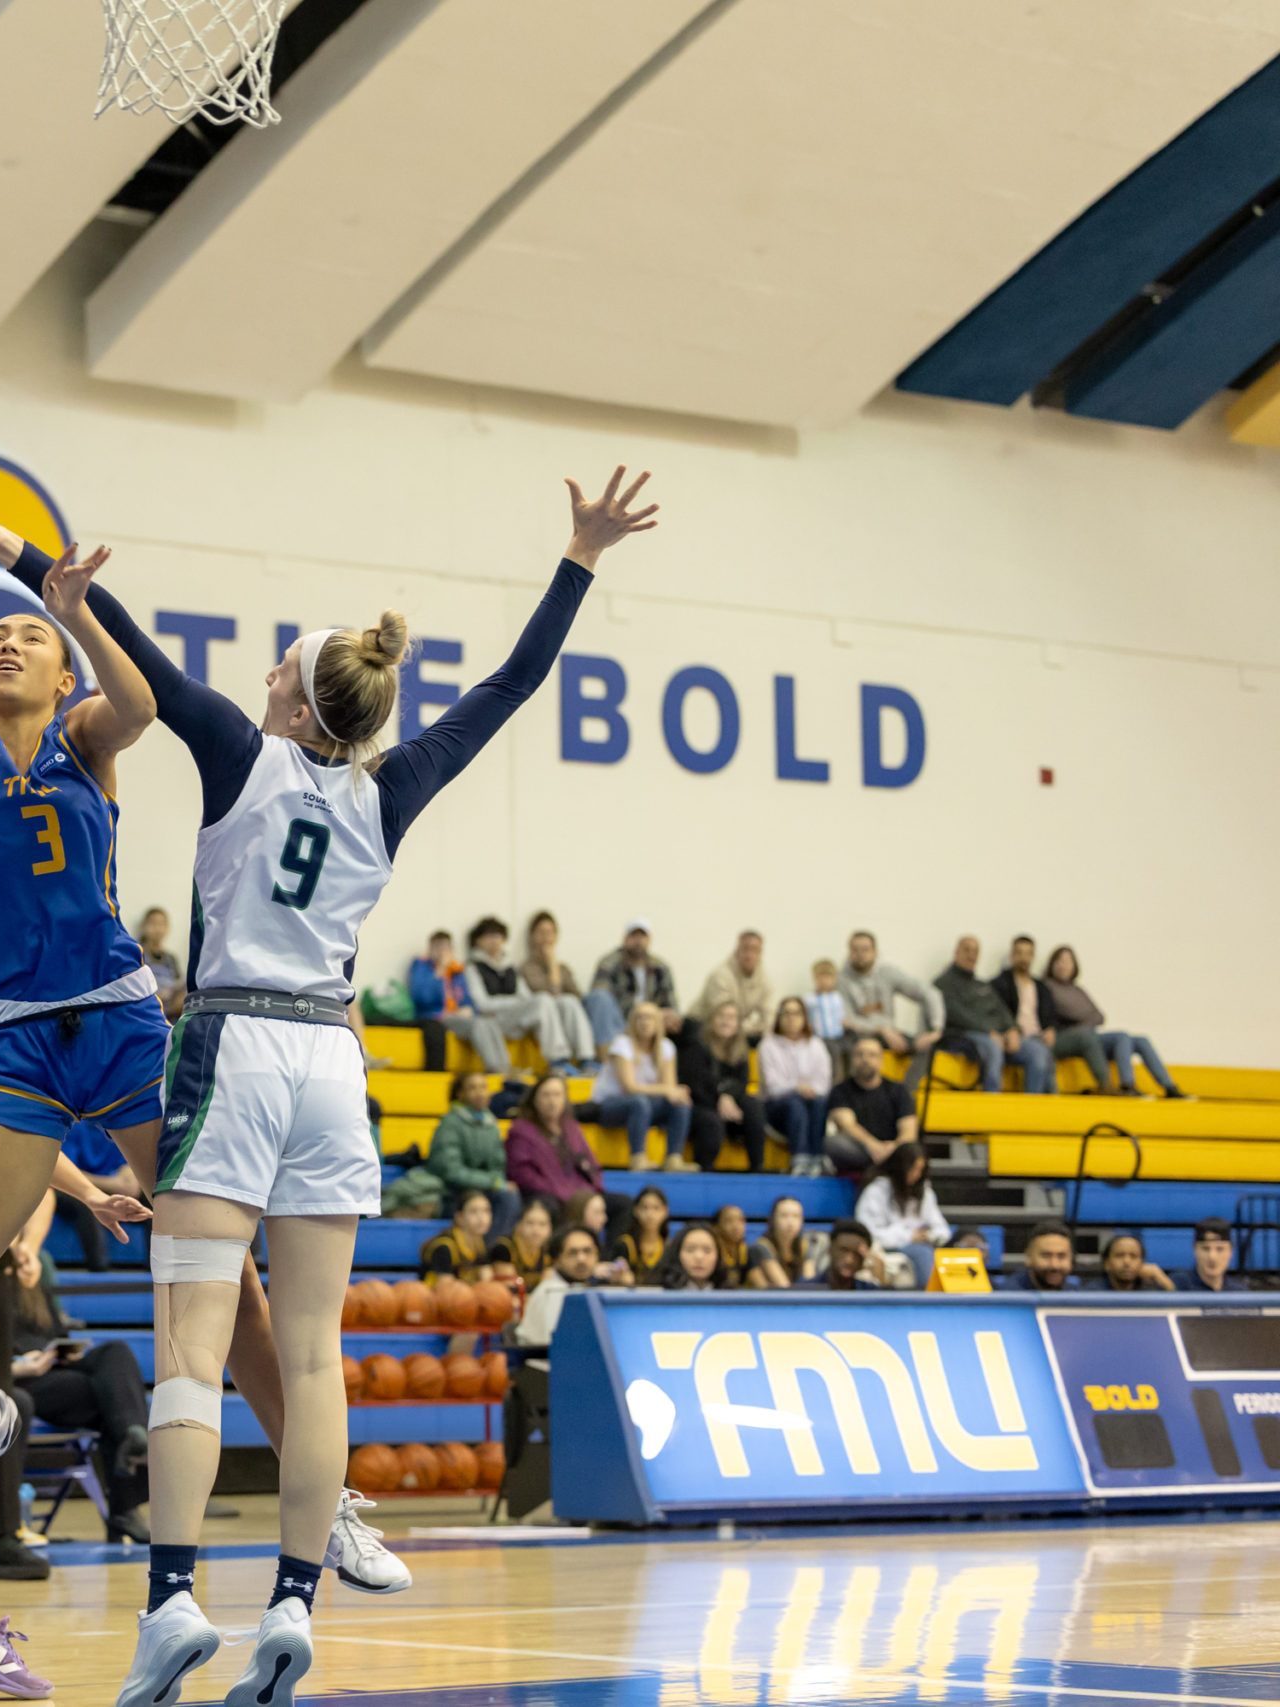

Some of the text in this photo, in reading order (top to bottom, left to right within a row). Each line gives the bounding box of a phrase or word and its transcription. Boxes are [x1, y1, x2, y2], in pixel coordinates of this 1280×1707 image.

[558, 652, 927, 790] BOLD
[20, 804, 66, 876] 3
[271, 817, 331, 911] 9
[650, 1330, 1040, 1478] TMU
[1082, 1383, 1160, 1411] BOLD
